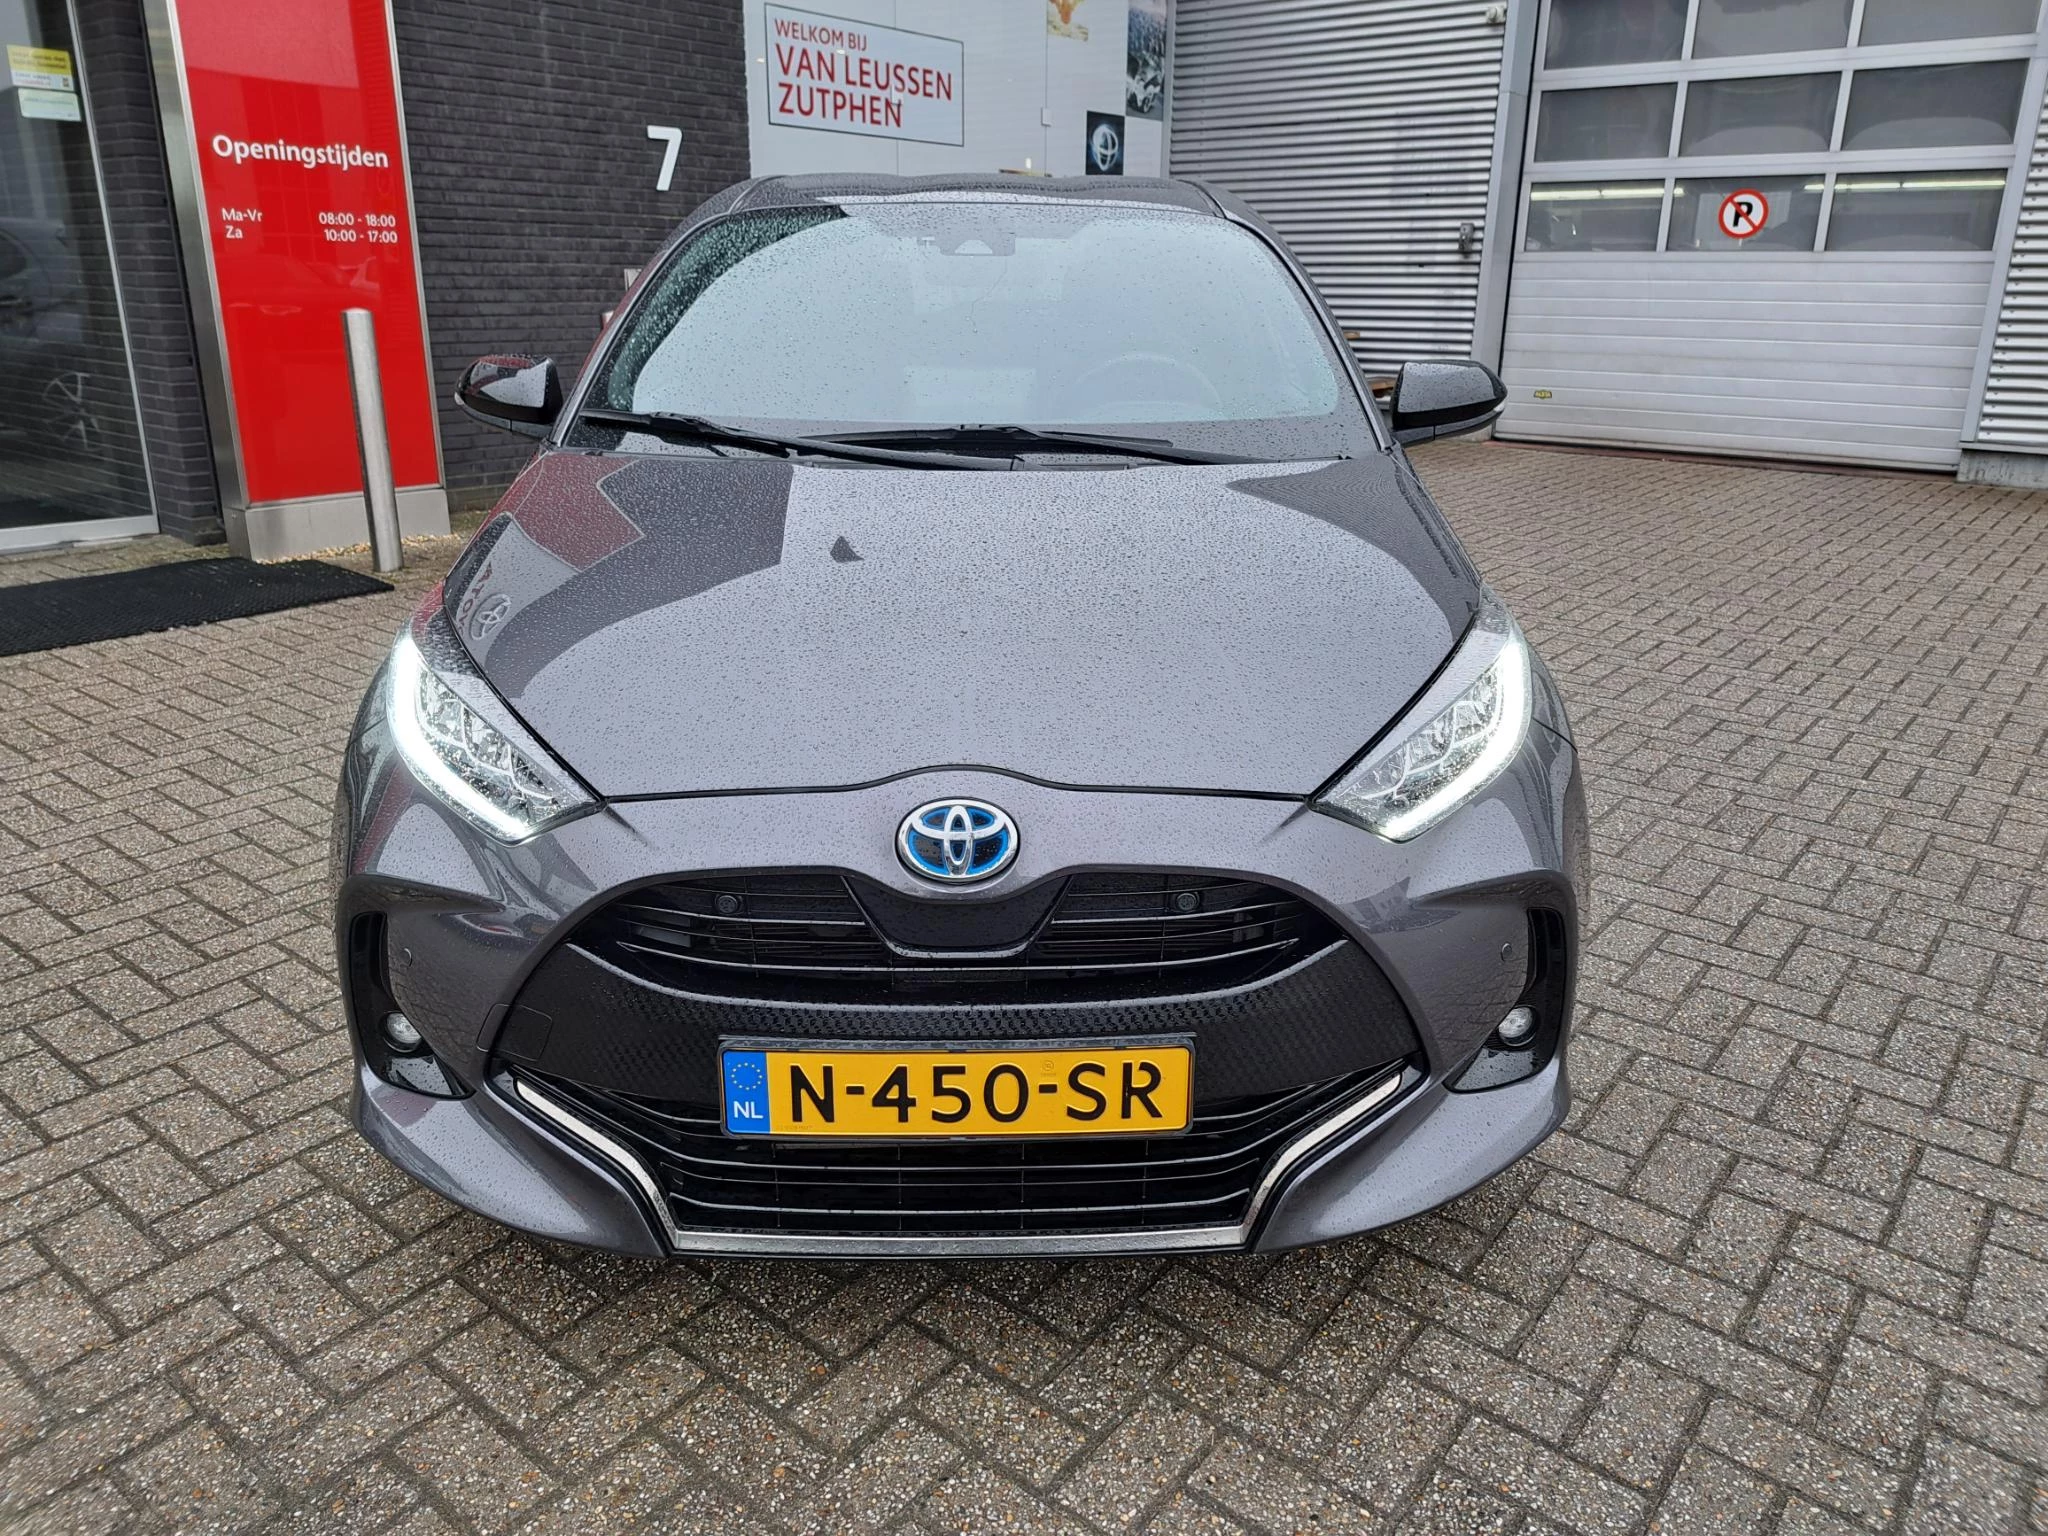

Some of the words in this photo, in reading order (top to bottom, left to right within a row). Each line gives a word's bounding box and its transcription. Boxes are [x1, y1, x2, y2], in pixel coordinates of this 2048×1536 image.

[774, 18, 844, 48] WELKOM
[848, 32, 867, 51] BIJ
[776, 43, 835, 83] VAN
[845, 56, 952, 101] LEUSSEN
[778, 82, 902, 128] ZUTPHEN
[212, 134, 389, 171] Openingstijden
[647, 125, 682, 191] 7
[222, 207, 263, 222] Ma-Vr
[318, 212, 354, 225] 08:00
[365, 214, 396, 227] 18:00
[1733, 202, 1753, 227] P
[226, 225, 243, 239] Za
[324, 229, 356, 242] 10:00
[367, 231, 398, 243] 17:00
[733, 1100, 764, 1119] NL
[789, 1060, 1163, 1123] N-450-SR
